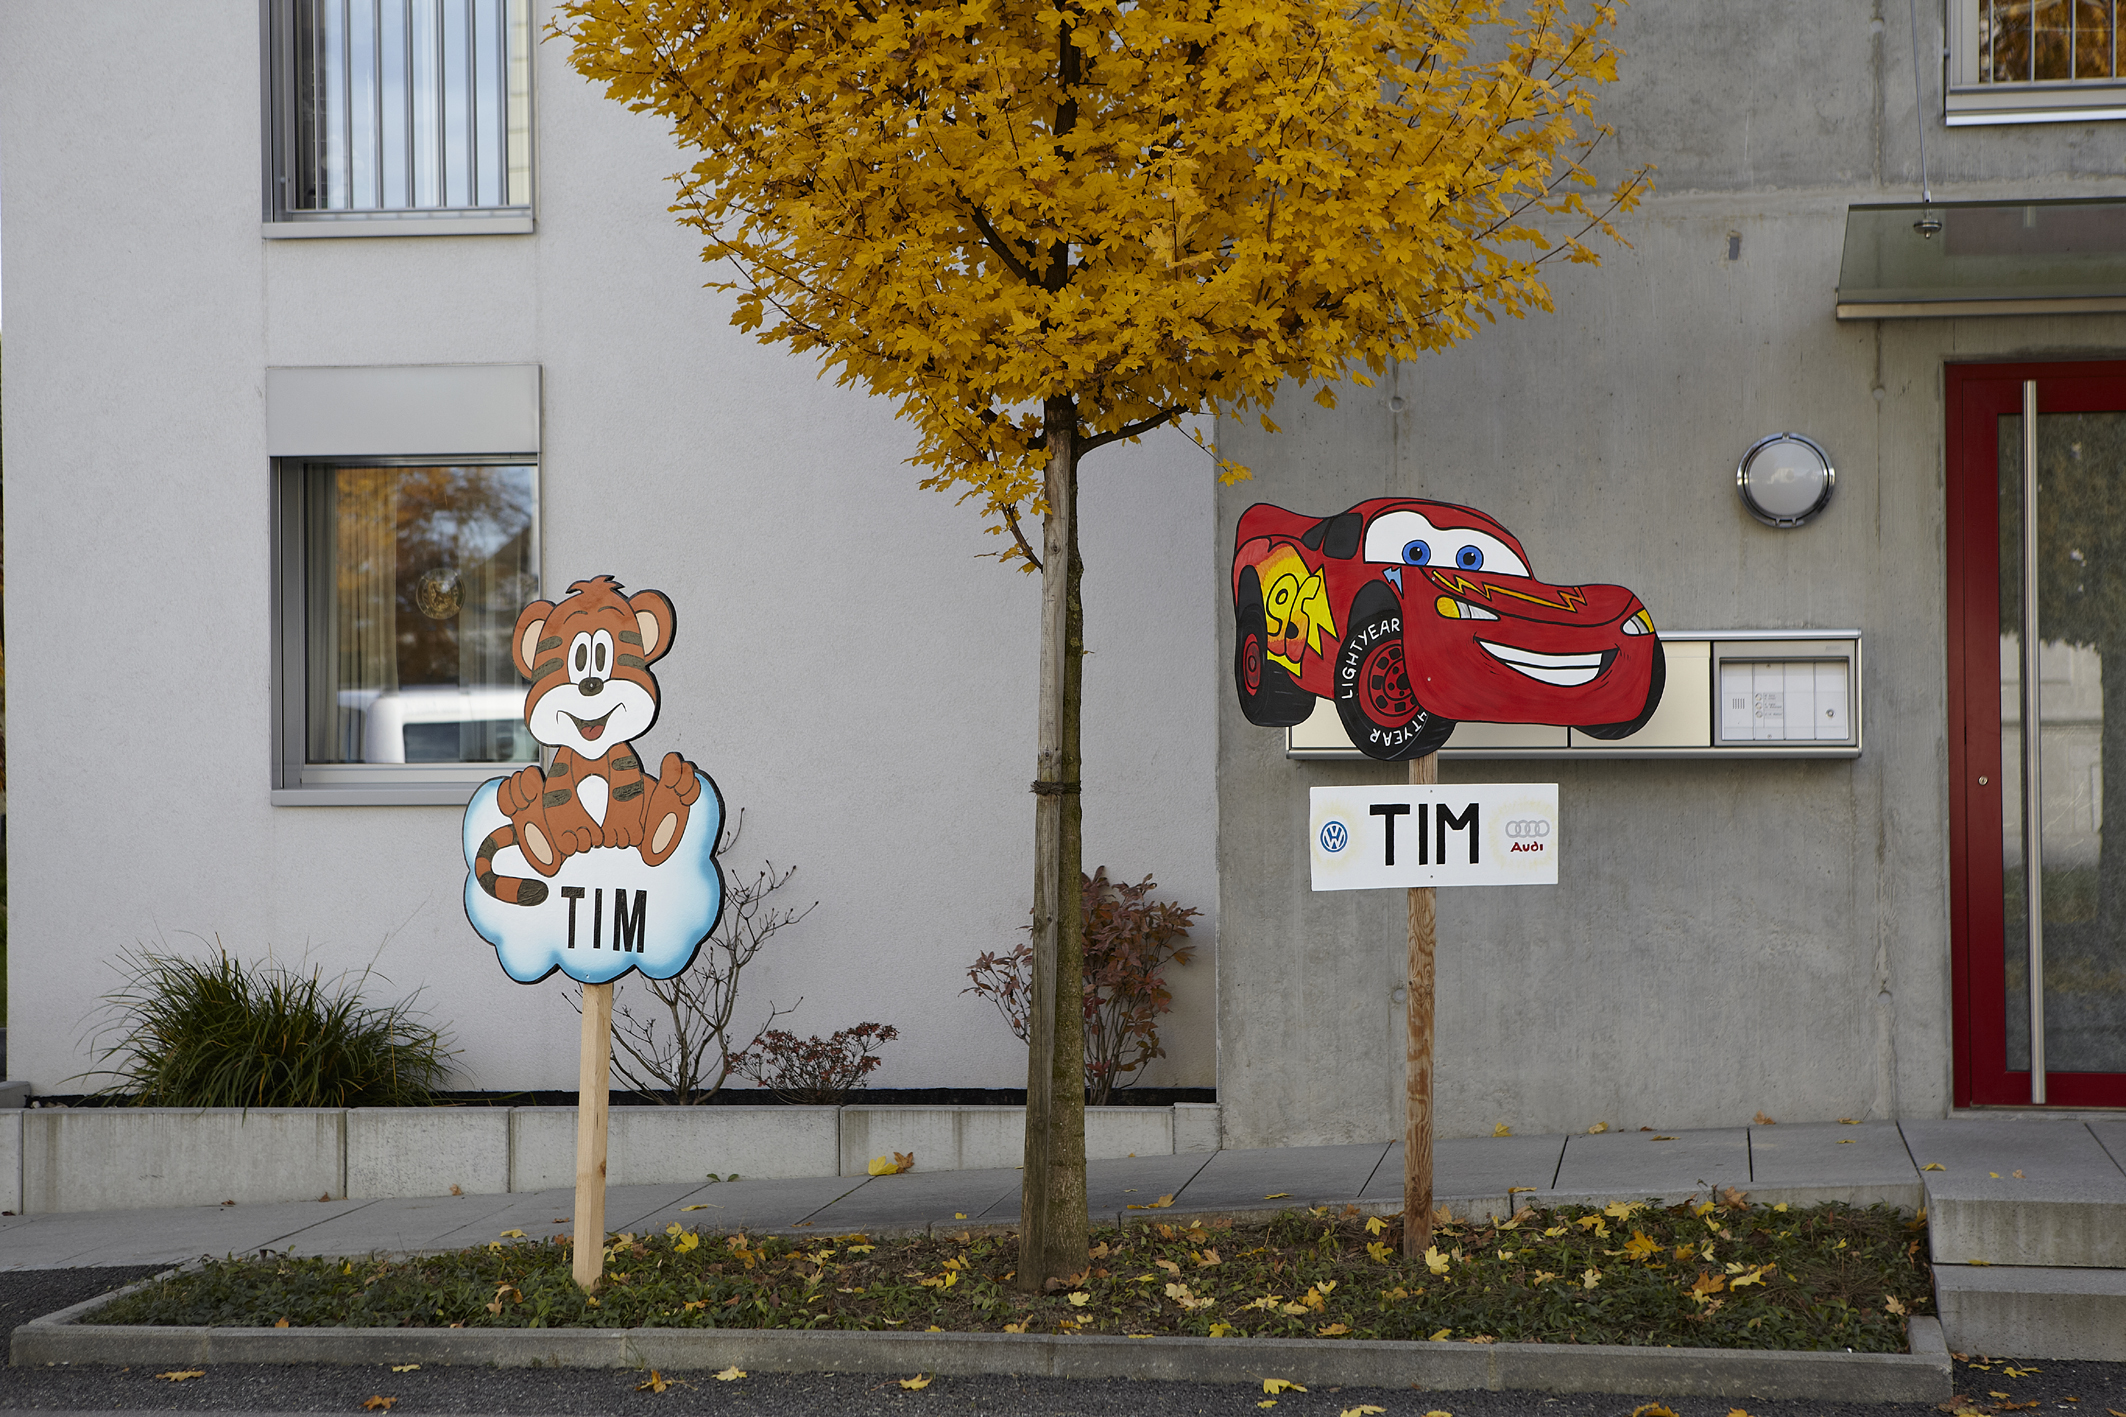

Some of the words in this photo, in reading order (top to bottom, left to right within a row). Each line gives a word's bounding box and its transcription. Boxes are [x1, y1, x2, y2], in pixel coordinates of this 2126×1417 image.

[1266, 573, 1321, 664] 95
[1341, 617, 1401, 699] LIGHTYEAR
[1369, 802, 1480, 866] TIM
[1510, 841, 1544, 852] Audi
[560, 886, 648, 954] TIM
